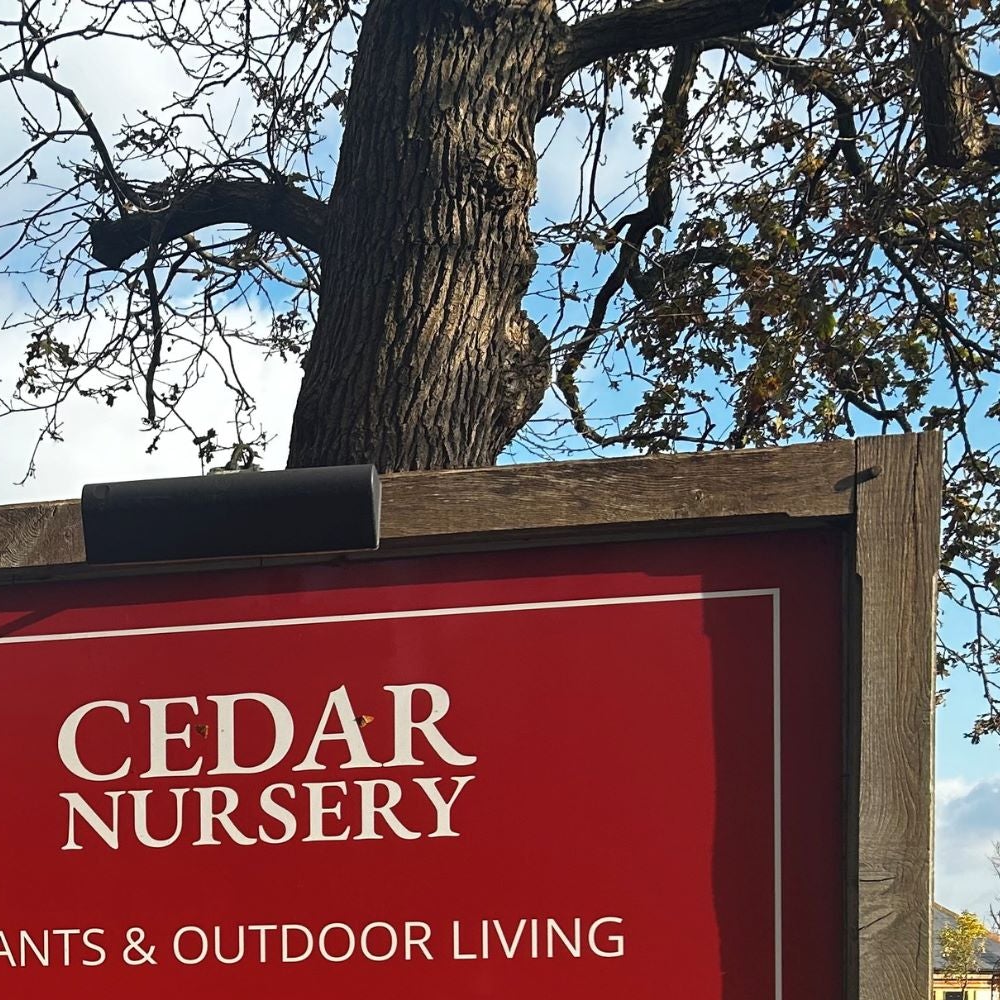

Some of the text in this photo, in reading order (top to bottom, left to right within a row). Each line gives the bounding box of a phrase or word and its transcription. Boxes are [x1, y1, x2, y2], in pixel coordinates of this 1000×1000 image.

[57, 683, 478, 782] CEDAR
[58, 775, 476, 851] NURSERY
[122, 927, 158, 966] &
[173, 921, 434, 965] OUTDOOR
[453, 916, 624, 960] LIVING
